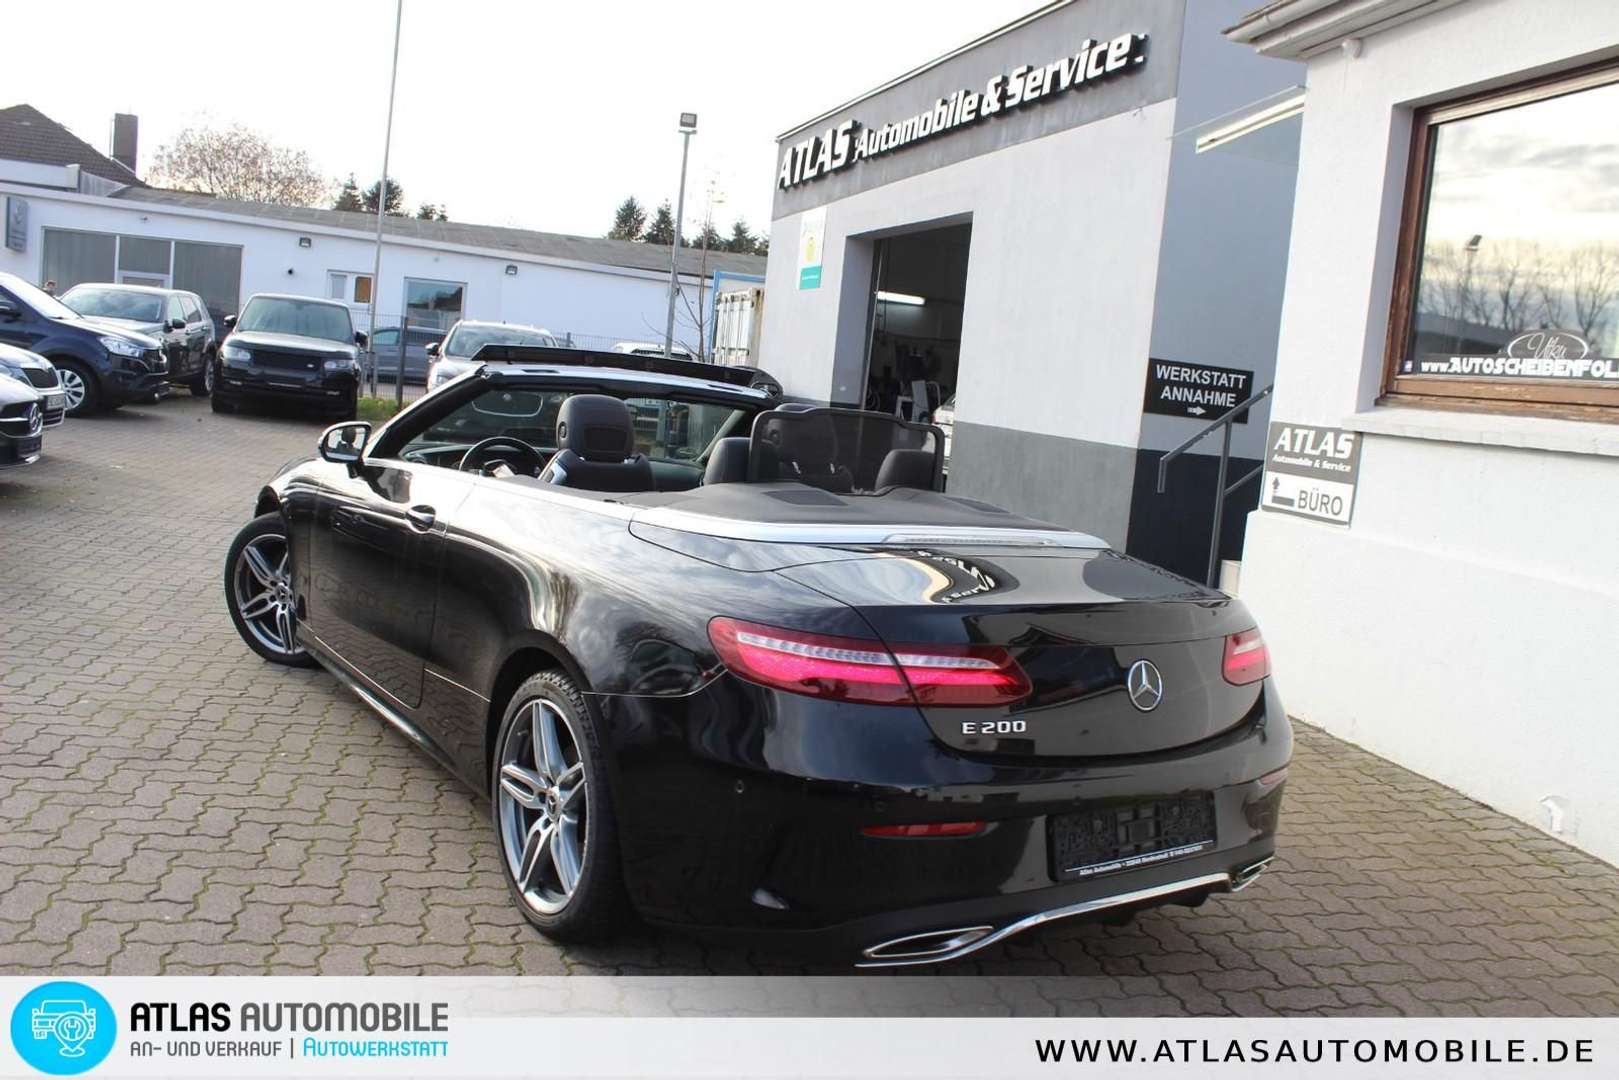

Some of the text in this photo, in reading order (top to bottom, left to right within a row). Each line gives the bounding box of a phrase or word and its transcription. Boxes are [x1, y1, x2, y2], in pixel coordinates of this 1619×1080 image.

[779, 119, 855, 189] ATLAS
[856, 90, 978, 160] Automobile
[981, 75, 1004, 118] &
[1156, 364, 1246, 389] WERKSTATT
[1421, 357, 1619, 379] www.AUTOSCHEIBENFOL
[1161, 385, 1236, 407] ANNAHME
[1274, 427, 1355, 459] ATLAS
[1298, 487, 1343, 516] BÜRO
[962, 721, 1026, 734] E 200
